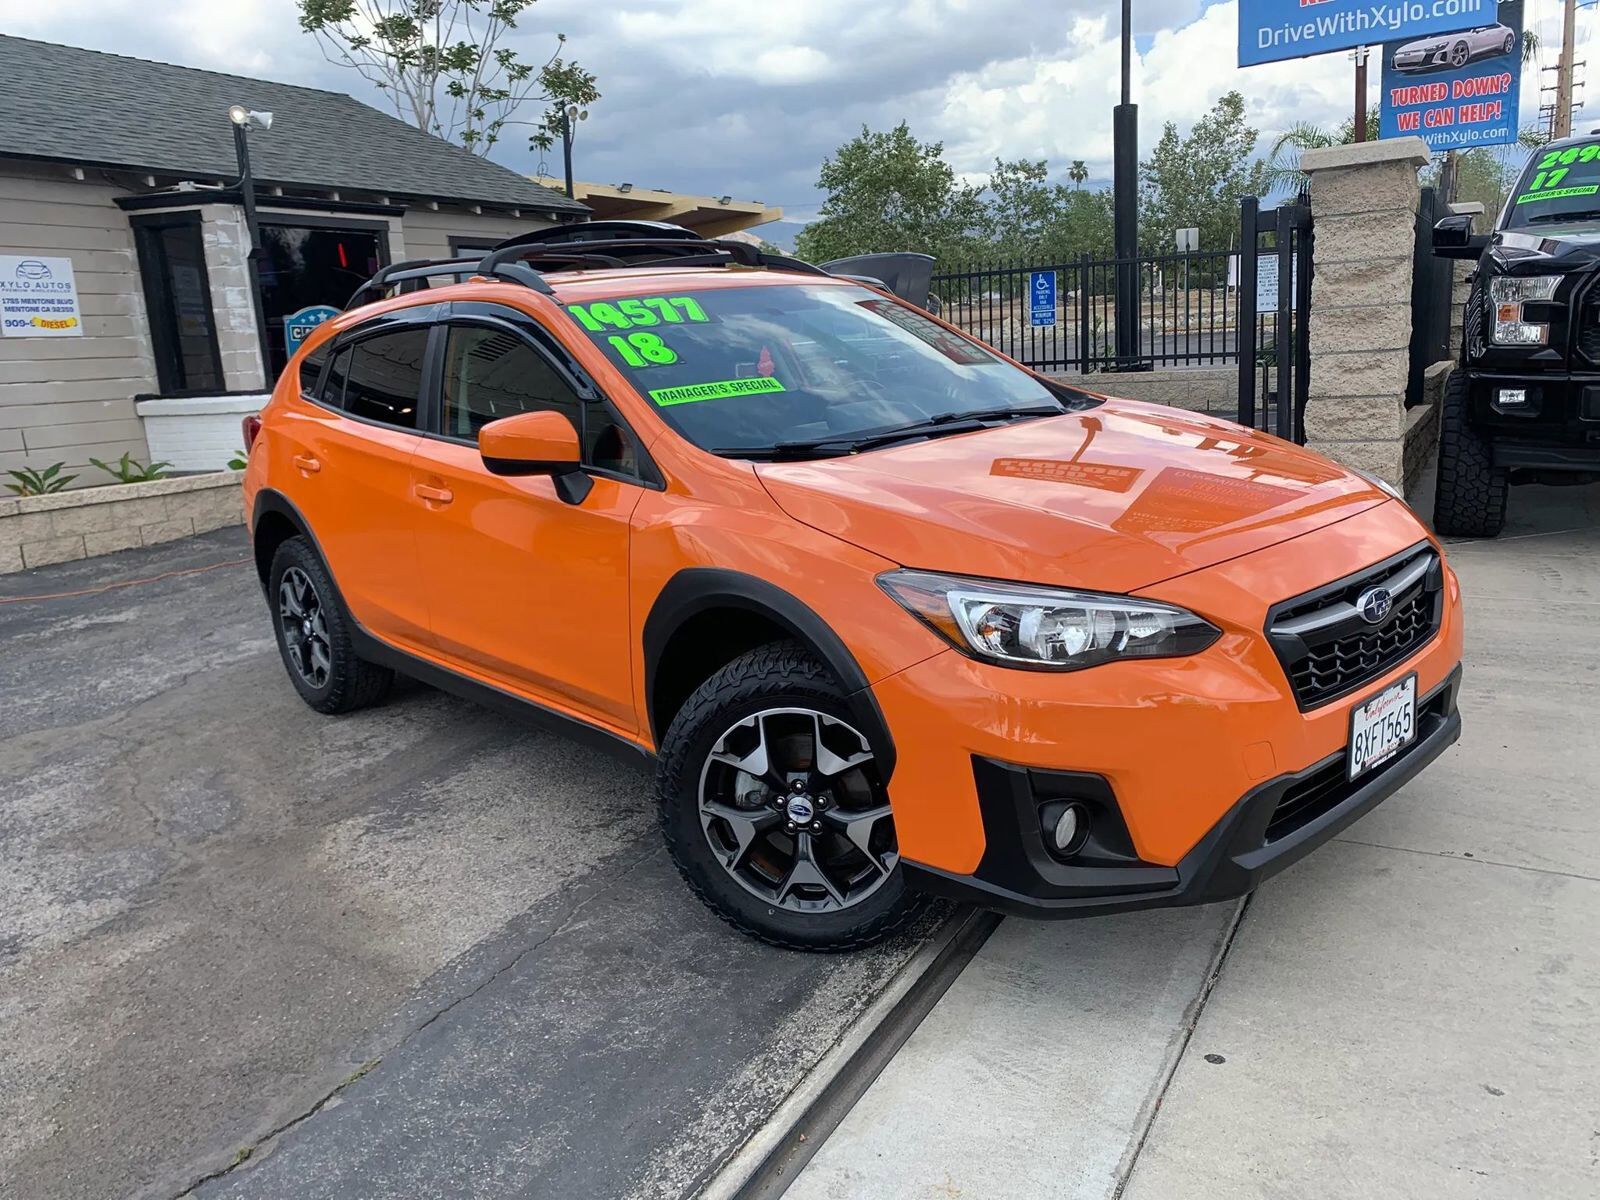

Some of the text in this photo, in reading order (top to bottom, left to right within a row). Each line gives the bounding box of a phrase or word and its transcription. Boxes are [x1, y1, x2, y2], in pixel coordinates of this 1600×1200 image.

[1257, 0, 1481, 49] DriveWithXylo.com
[1391, 72, 1512, 107] TURNED DOWN?
[1397, 100, 1502, 131] WE CAN HELP!
[1421, 127, 1509, 145] WithXylo.com
[1537, 145, 1600, 169] 249
[1529, 168, 1570, 190] 17
[1563, 186, 1596, 195] SPECIAL
[0, 281, 72, 290] XYLO AUTOS
[41, 319, 70, 329] DIESEL
[568, 297, 710, 331] 14577
[607, 332, 678, 367] 18
[657, 379, 777, 403] MANAGER'S SPECIAL
[1354, 702, 1411, 765] 8XFT565
